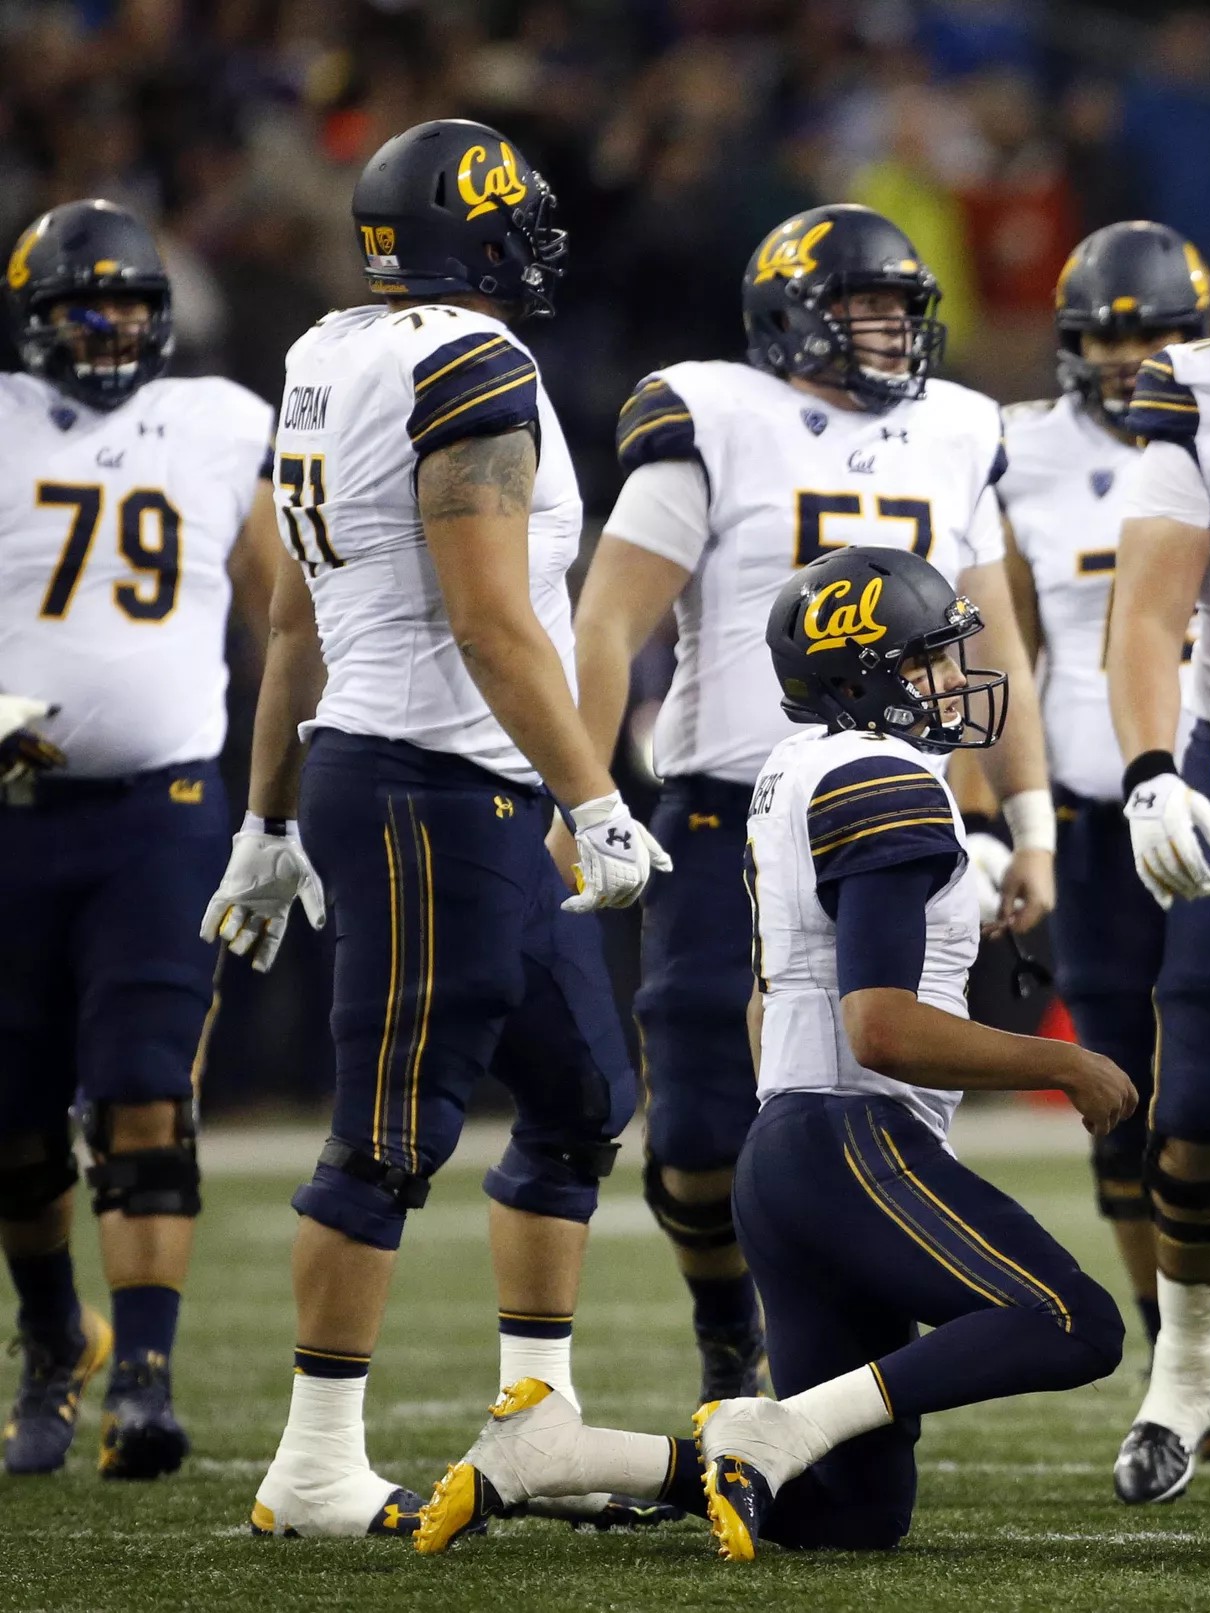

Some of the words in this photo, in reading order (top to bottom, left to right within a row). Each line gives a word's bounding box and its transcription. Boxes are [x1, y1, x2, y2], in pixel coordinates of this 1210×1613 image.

[457, 142, 527, 220] Cal
[753, 219, 834, 285] Cal
[35, 480, 183, 625] 79
[803, 577, 887, 655] Cal
